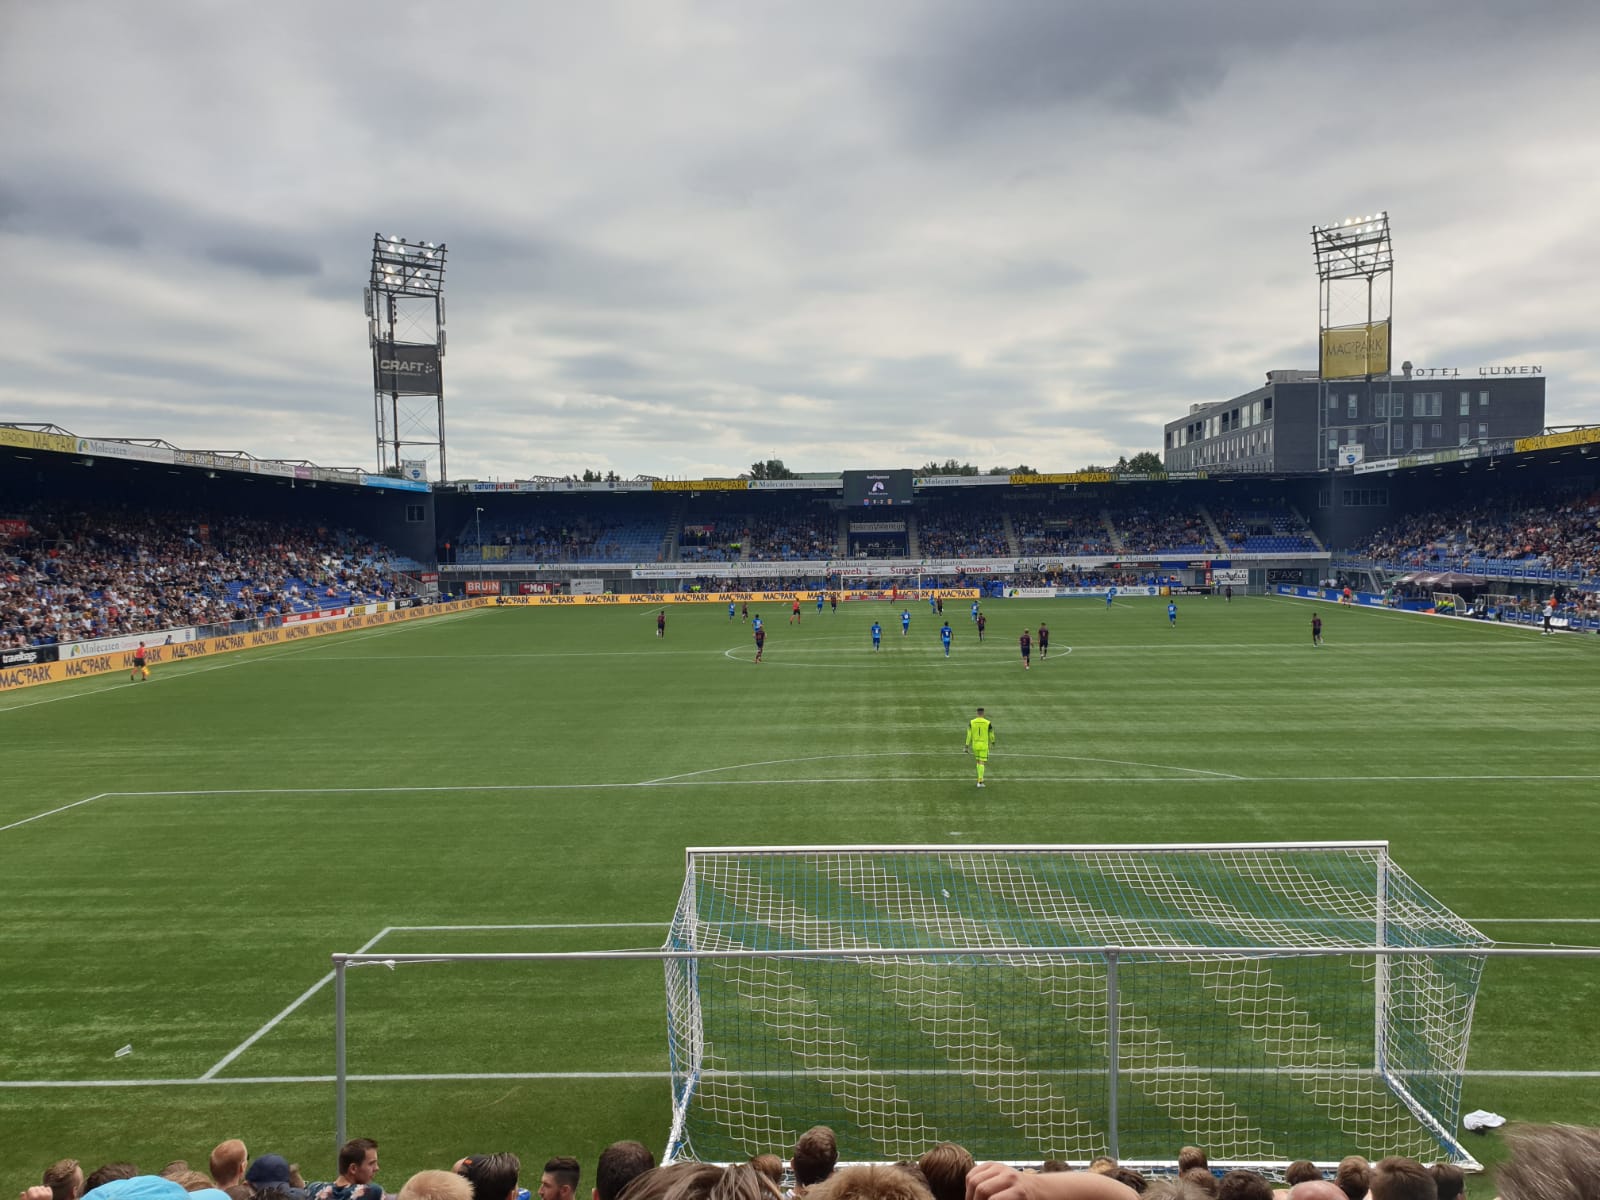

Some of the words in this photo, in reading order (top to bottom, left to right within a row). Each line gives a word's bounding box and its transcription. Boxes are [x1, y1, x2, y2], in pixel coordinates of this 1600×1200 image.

[380, 360, 425, 372] CRAFT
[1410, 367, 1461, 377] OTEL
[1479, 366, 1542, 376] LUMEN
[826, 567, 862, 576] Sunweb
[955, 565, 992, 574] Sunweb
[81, 643, 120, 656] Molecaten
[2, 651, 38, 664] travelbags
